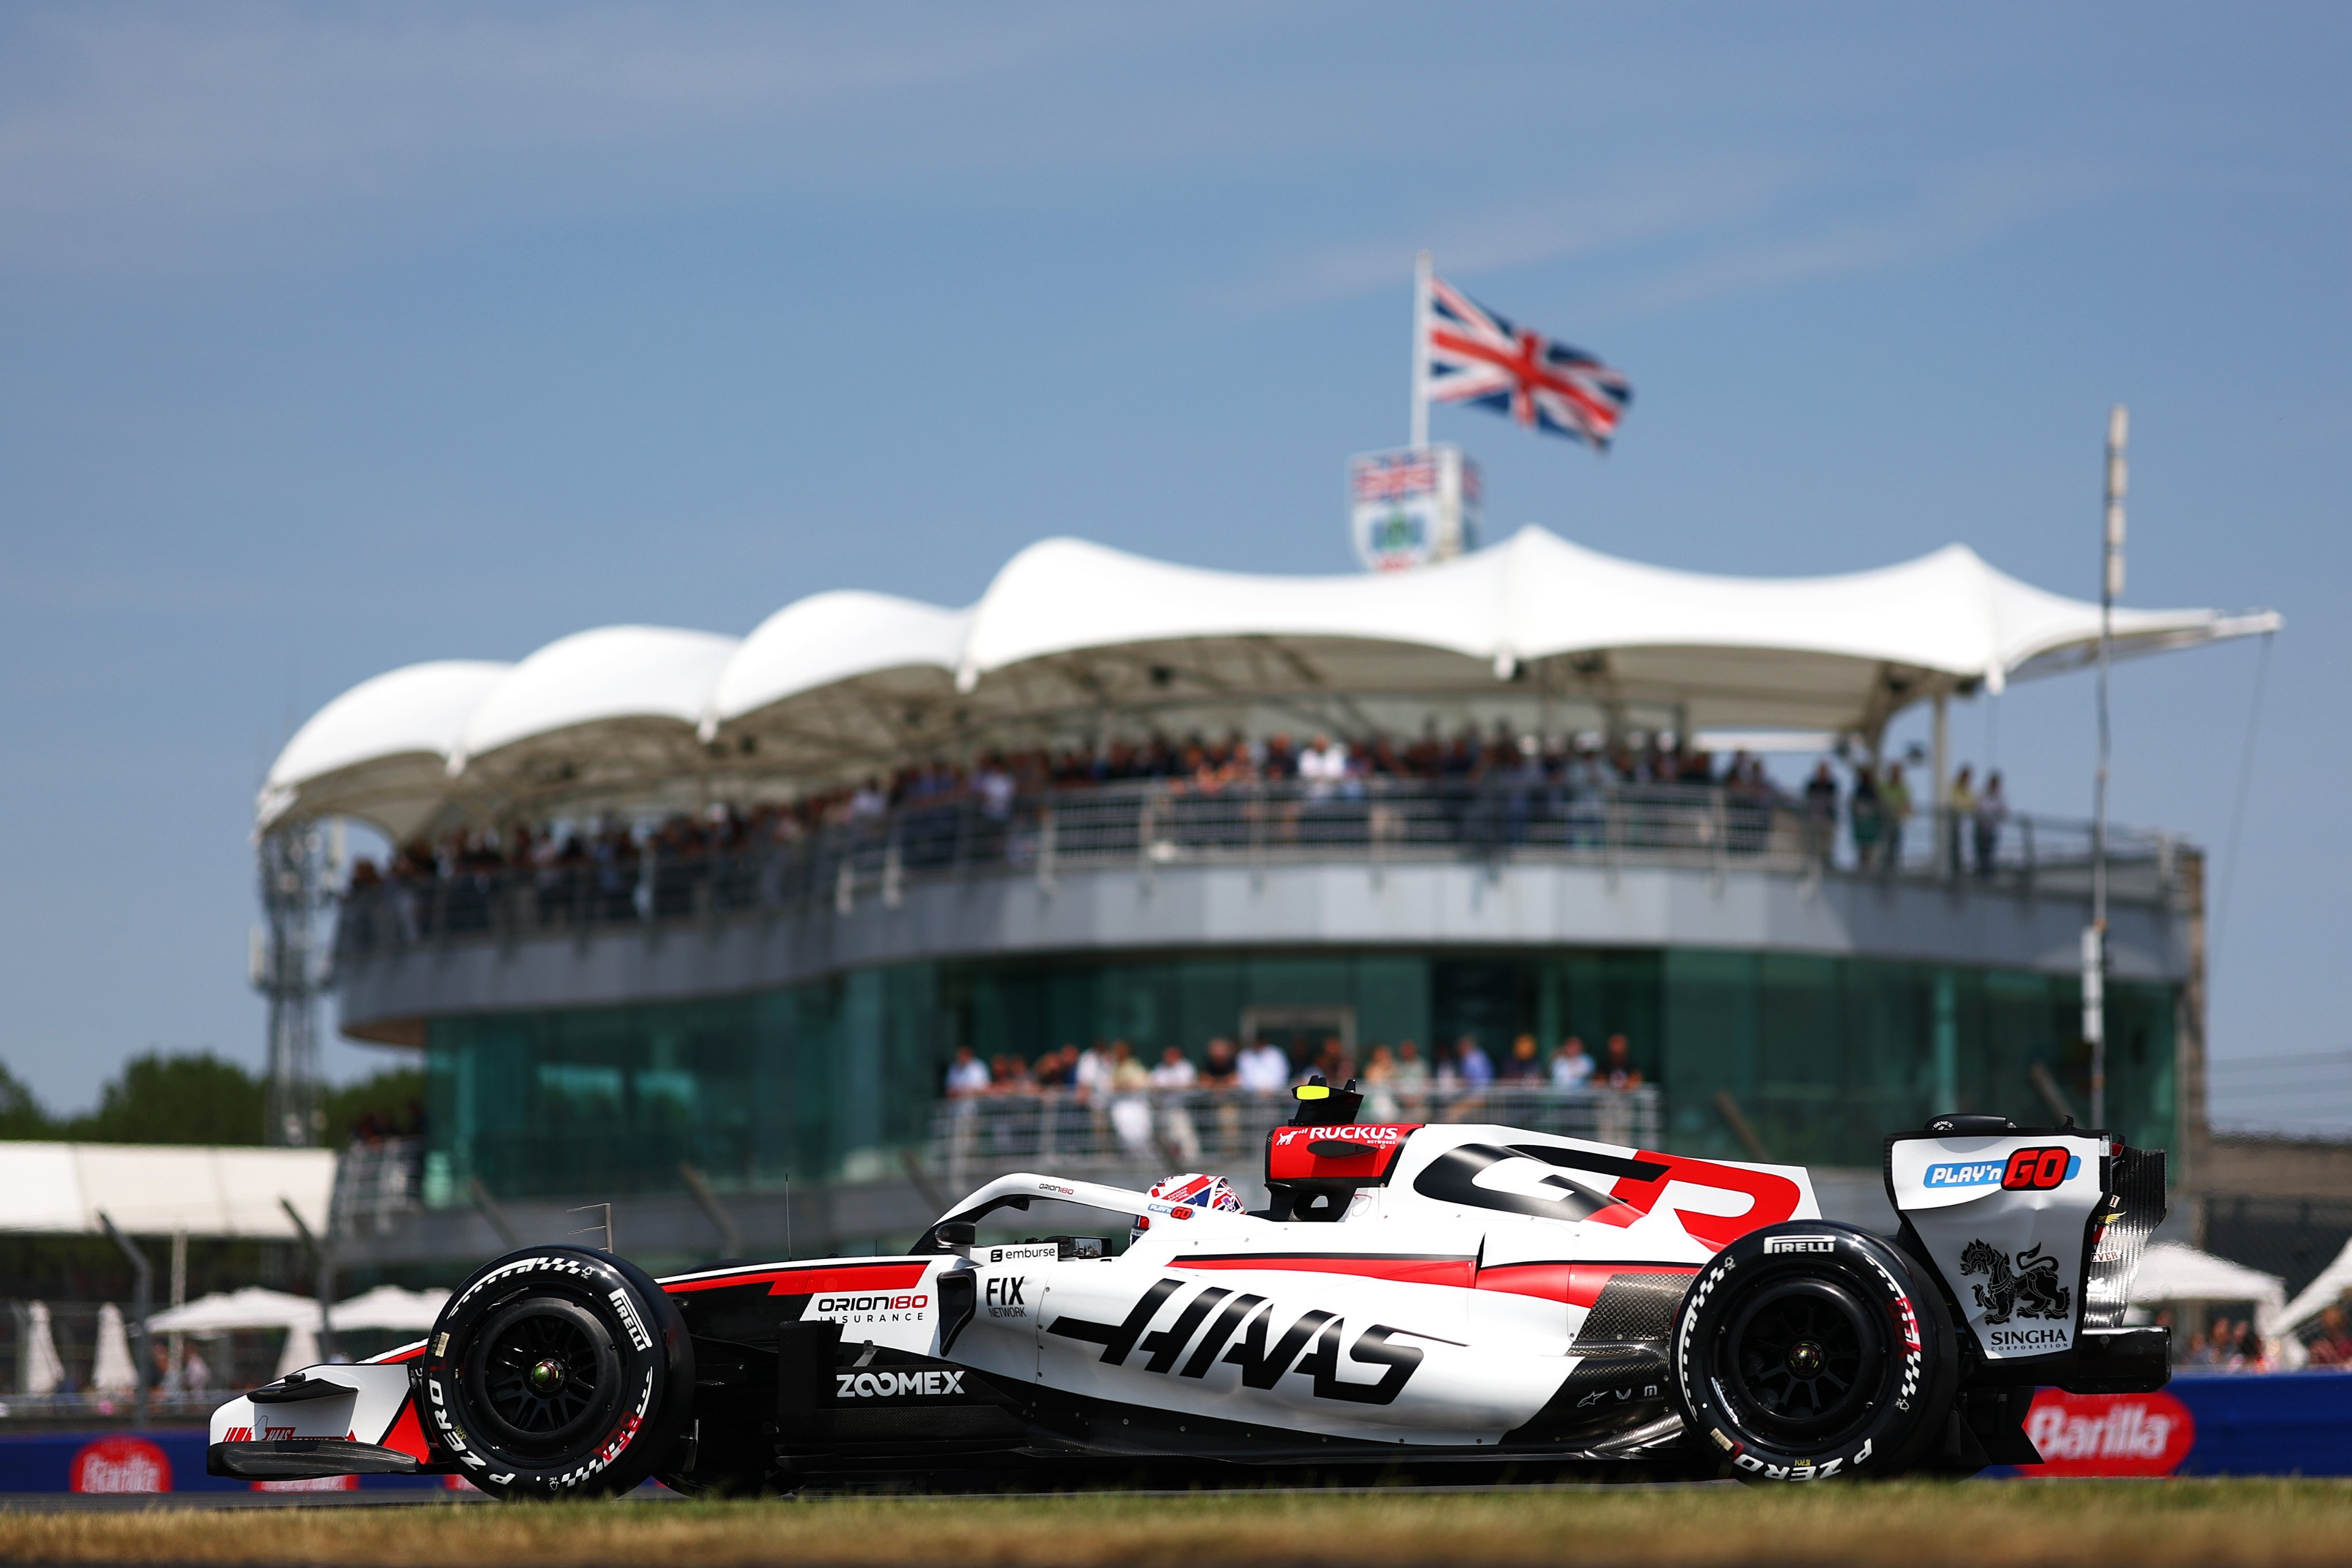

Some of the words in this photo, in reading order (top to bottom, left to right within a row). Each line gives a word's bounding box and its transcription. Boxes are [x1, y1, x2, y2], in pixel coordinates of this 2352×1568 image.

[1309, 1127, 1398, 1140] RUCKUS
[1931, 1165, 2002, 1184] PLAY'n
[2004, 1149, 2070, 1187] GO
[1039, 1183, 1074, 1195] ORION180
[1171, 1207, 1193, 1218] GO
[1005, 1247, 1055, 1259] emburse
[1763, 1234, 1836, 1254] PIRELLI
[986, 1276, 1025, 1306] FIX
[818, 1295, 928, 1312] ORION180
[988, 1307, 1027, 1317] NETWORK
[608, 1288, 653, 1352] PIRELLI
[1046, 1278, 1470, 1406] HAAS
[1991, 1329, 2067, 1345] SINGHA
[1991, 1343, 2068, 1351] CORPORATION
[836, 1371, 965, 1397] ZOOMEX
[429, 1379, 486, 1471] ZERO
[2029, 1401, 2171, 1459] Barilla
[1854, 1438, 1872, 1464] P
[1734, 1454, 1843, 1481] ZERO
[489, 1473, 515, 1485] P
